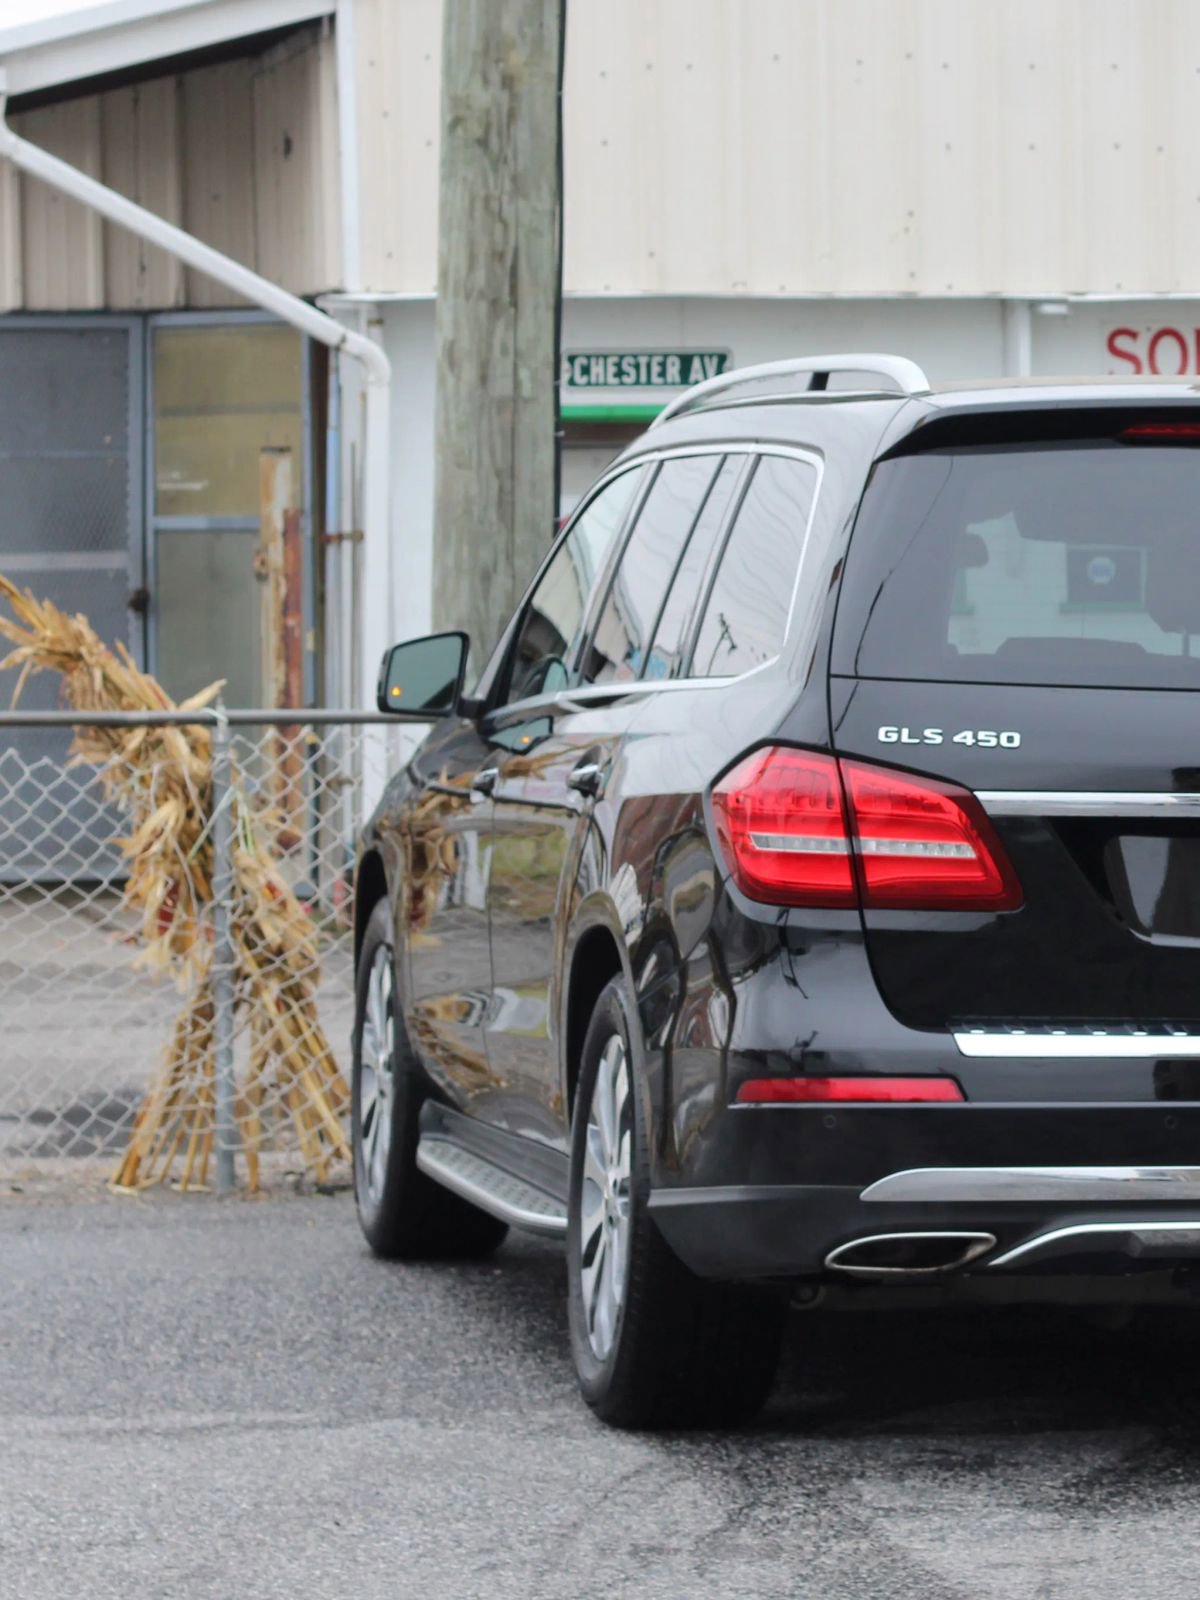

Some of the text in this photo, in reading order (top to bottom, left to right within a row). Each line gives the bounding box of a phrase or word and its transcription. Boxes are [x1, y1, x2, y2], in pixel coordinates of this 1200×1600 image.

[573, 355, 718, 385] CHESTER AV
[878, 726, 1021, 748] GLS 450
